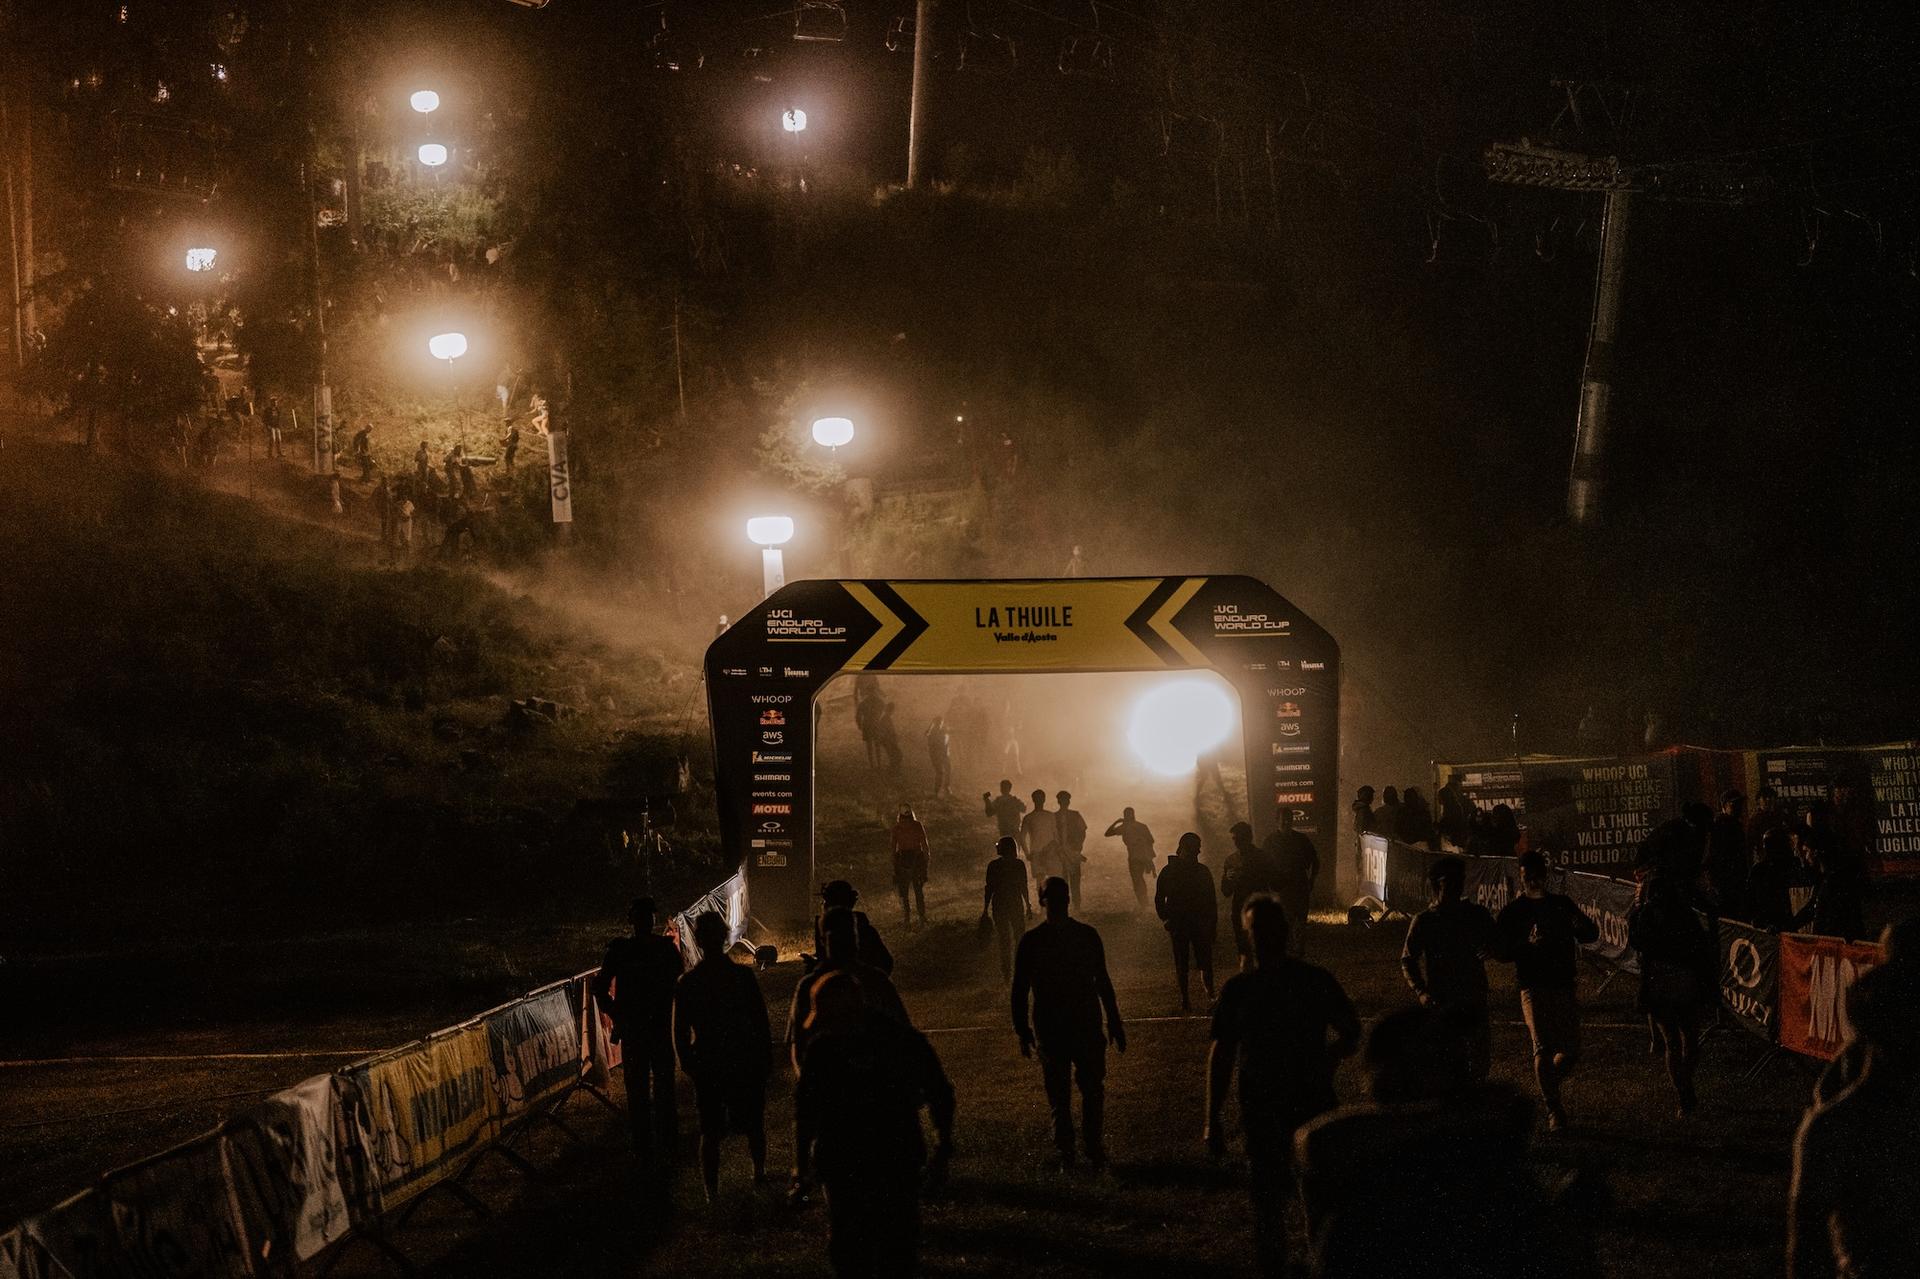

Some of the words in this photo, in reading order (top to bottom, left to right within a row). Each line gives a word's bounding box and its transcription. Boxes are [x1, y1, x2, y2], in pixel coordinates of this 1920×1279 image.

[552, 460, 569, 500] CVA
[770, 609, 793, 619] UCI
[1217, 604, 1238, 614] UCI
[975, 606, 1000, 628] LA
[1005, 606, 1073, 627] THUILE
[1213, 614, 1268, 622] ENDURO
[766, 619, 824, 627] ENDURO
[1214, 622, 1262, 630] WORLD
[1263, 621, 1290, 629] CUP
[766, 627, 817, 635] WORLD
[819, 627, 847, 635] CUP
[994, 632, 1020, 644] Valle
[1267, 687, 1306, 697] WHOOP
[751, 695, 792, 704] WHOOP
[1280, 723, 1300, 731] aws
[762, 731, 784, 739] aws
[753, 774, 791, 782] SHIMANO
[1583, 766, 1626, 782] WHOOP
[1629, 765, 1648, 779] UCI
[1278, 793, 1313, 803] MOTUL
[753, 804, 791, 814] MOTUL
[1890, 802, 1906, 817] LA
[1590, 815, 1607, 829] LA
[1609, 812, 1649, 829] THUILE
[1878, 819, 1914, 834] VALLE
[1577, 830, 1613, 846] VALLE
[1560, 850, 1570, 866] 6
[1572, 848, 1621, 865] LUGLIO
